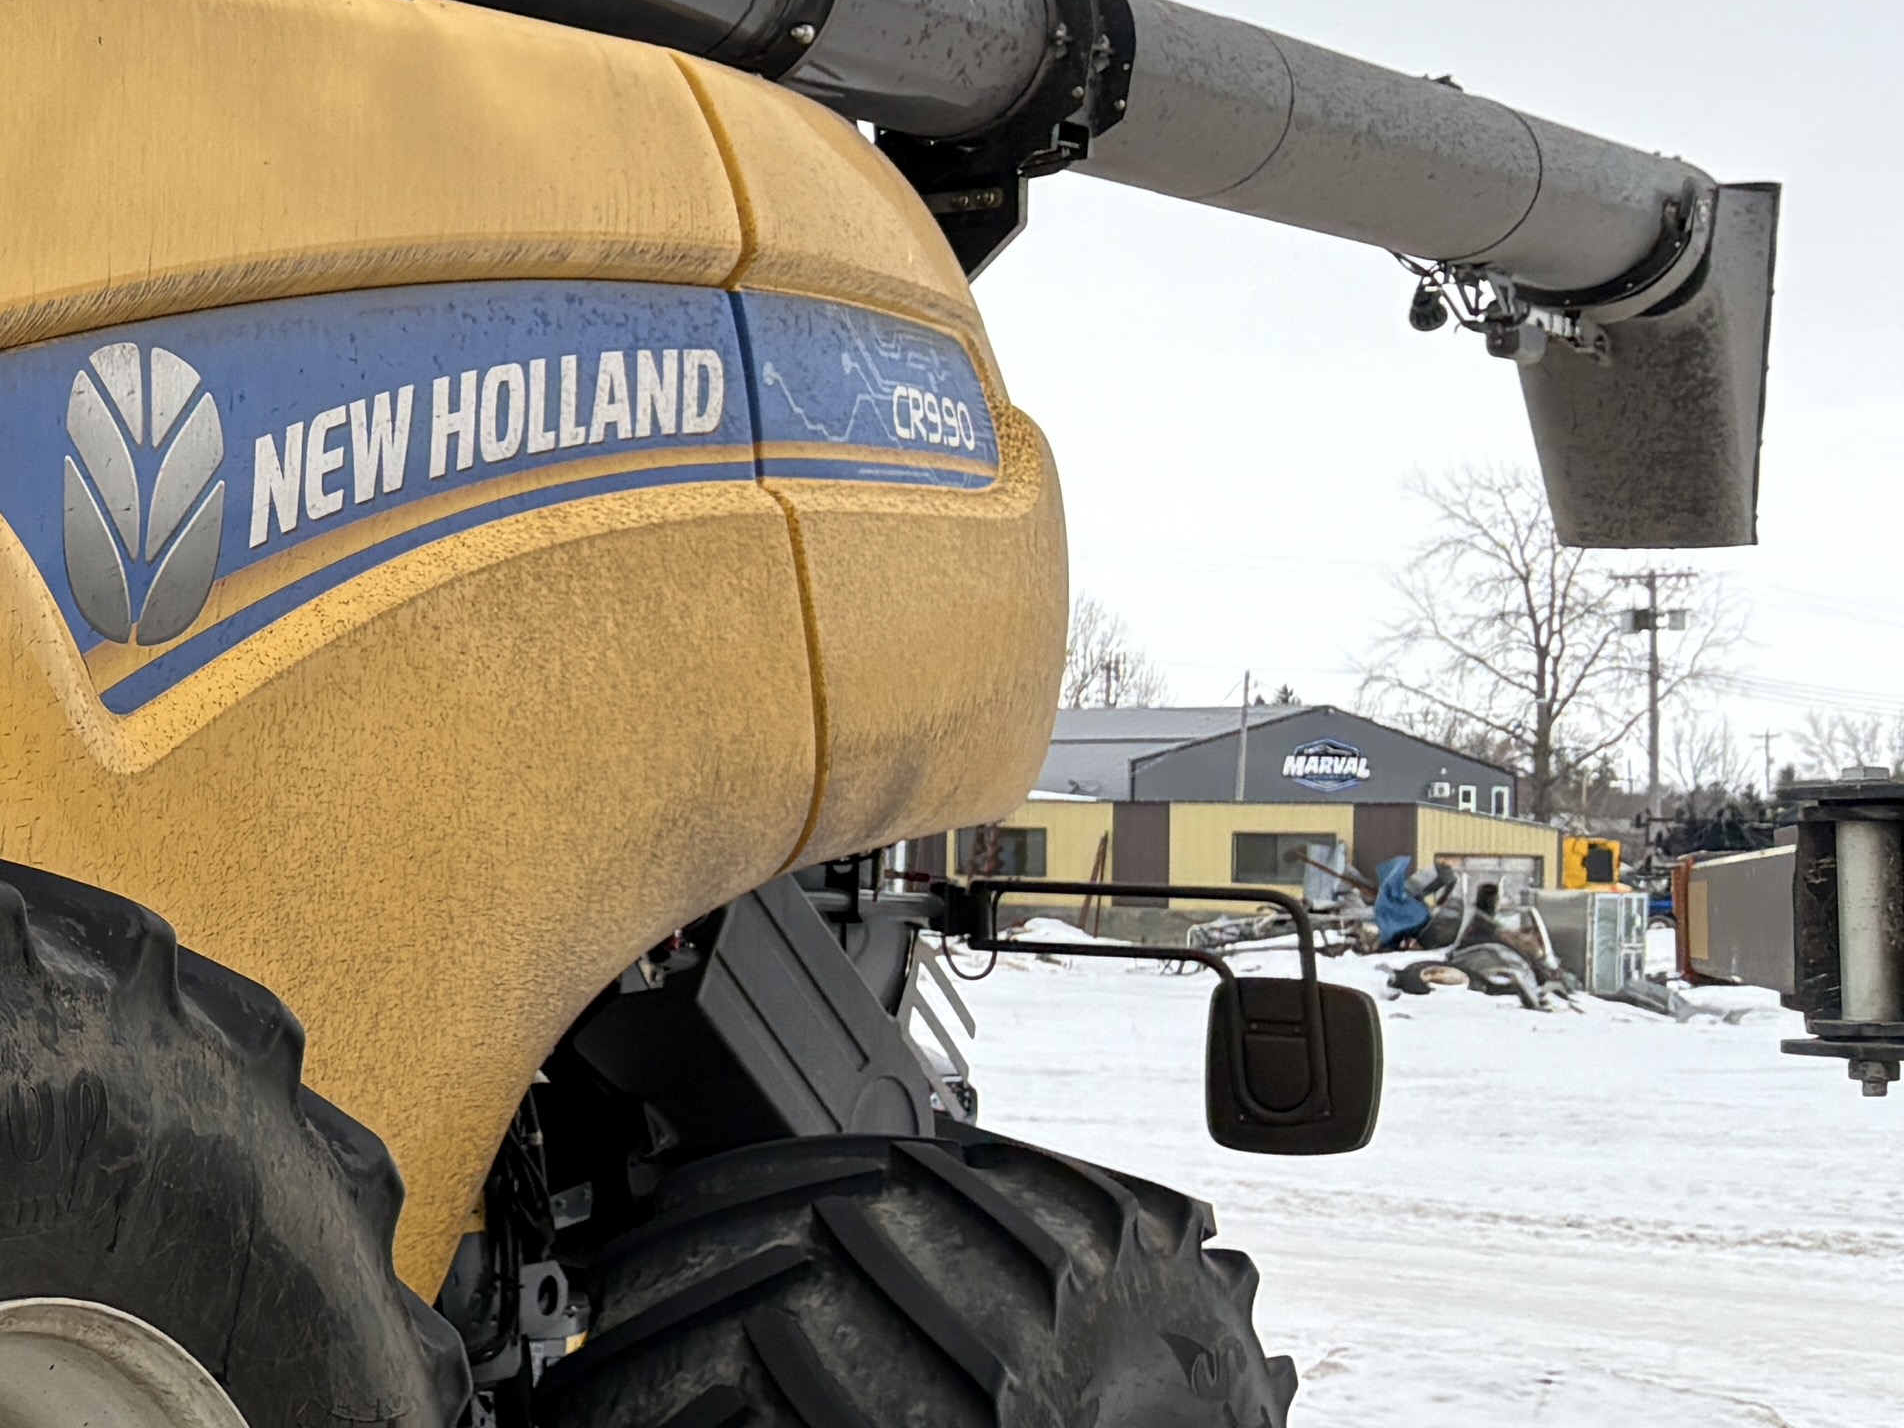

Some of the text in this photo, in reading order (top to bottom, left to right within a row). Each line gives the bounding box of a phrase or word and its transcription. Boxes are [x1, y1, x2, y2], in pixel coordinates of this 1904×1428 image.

[249, 348, 725, 549] NEW HOLLAND
[893, 384, 976, 452] CR9.90
[1282, 755, 1371, 779] MARVAL
